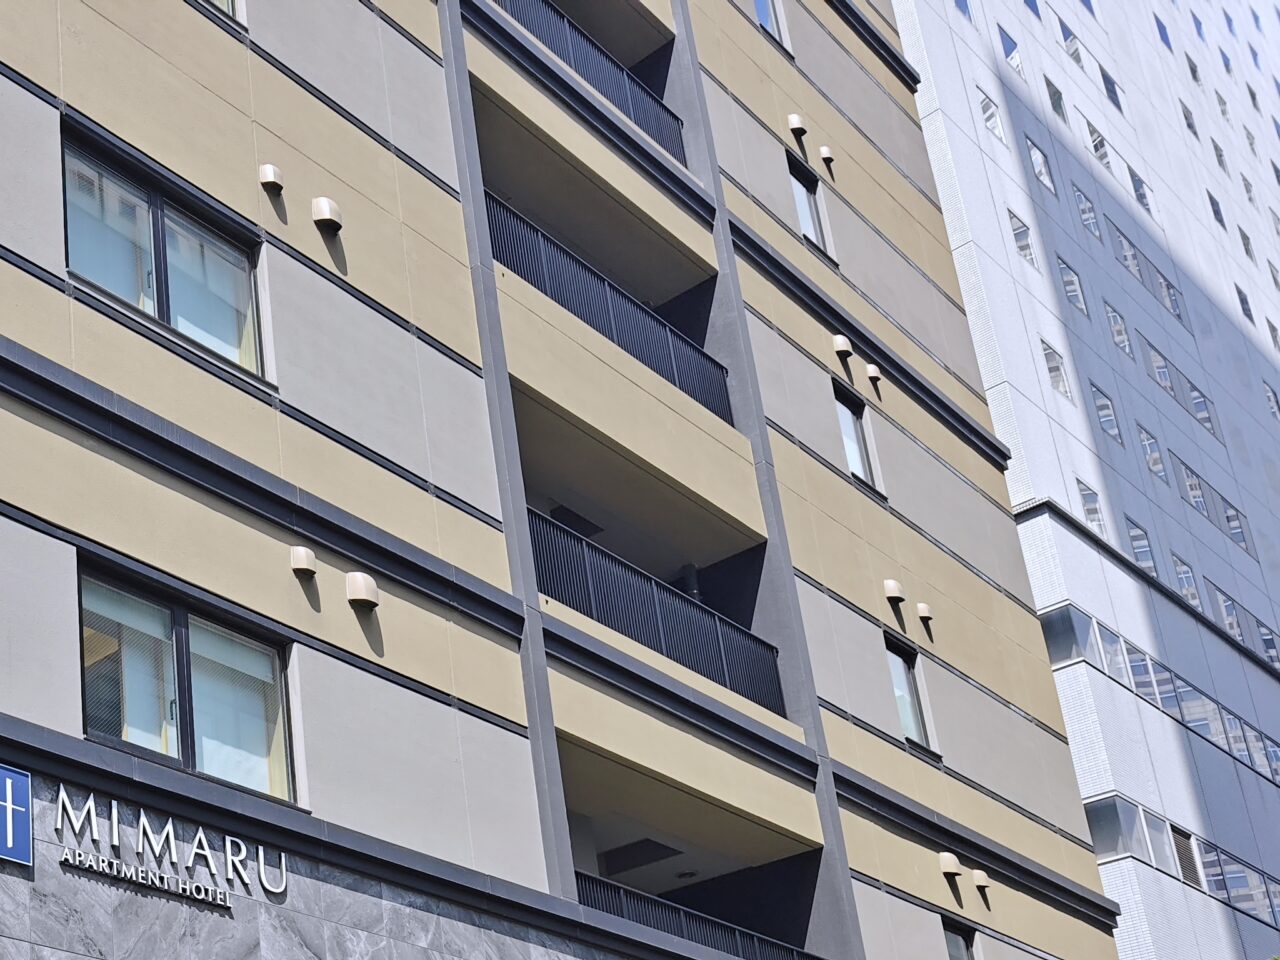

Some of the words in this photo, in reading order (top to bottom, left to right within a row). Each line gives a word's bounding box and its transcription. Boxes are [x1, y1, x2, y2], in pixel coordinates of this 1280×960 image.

[54, 782, 288, 894] MIMARU
[60, 846, 170, 890] APARTMENT
[178, 878, 233, 908] HOTEL
